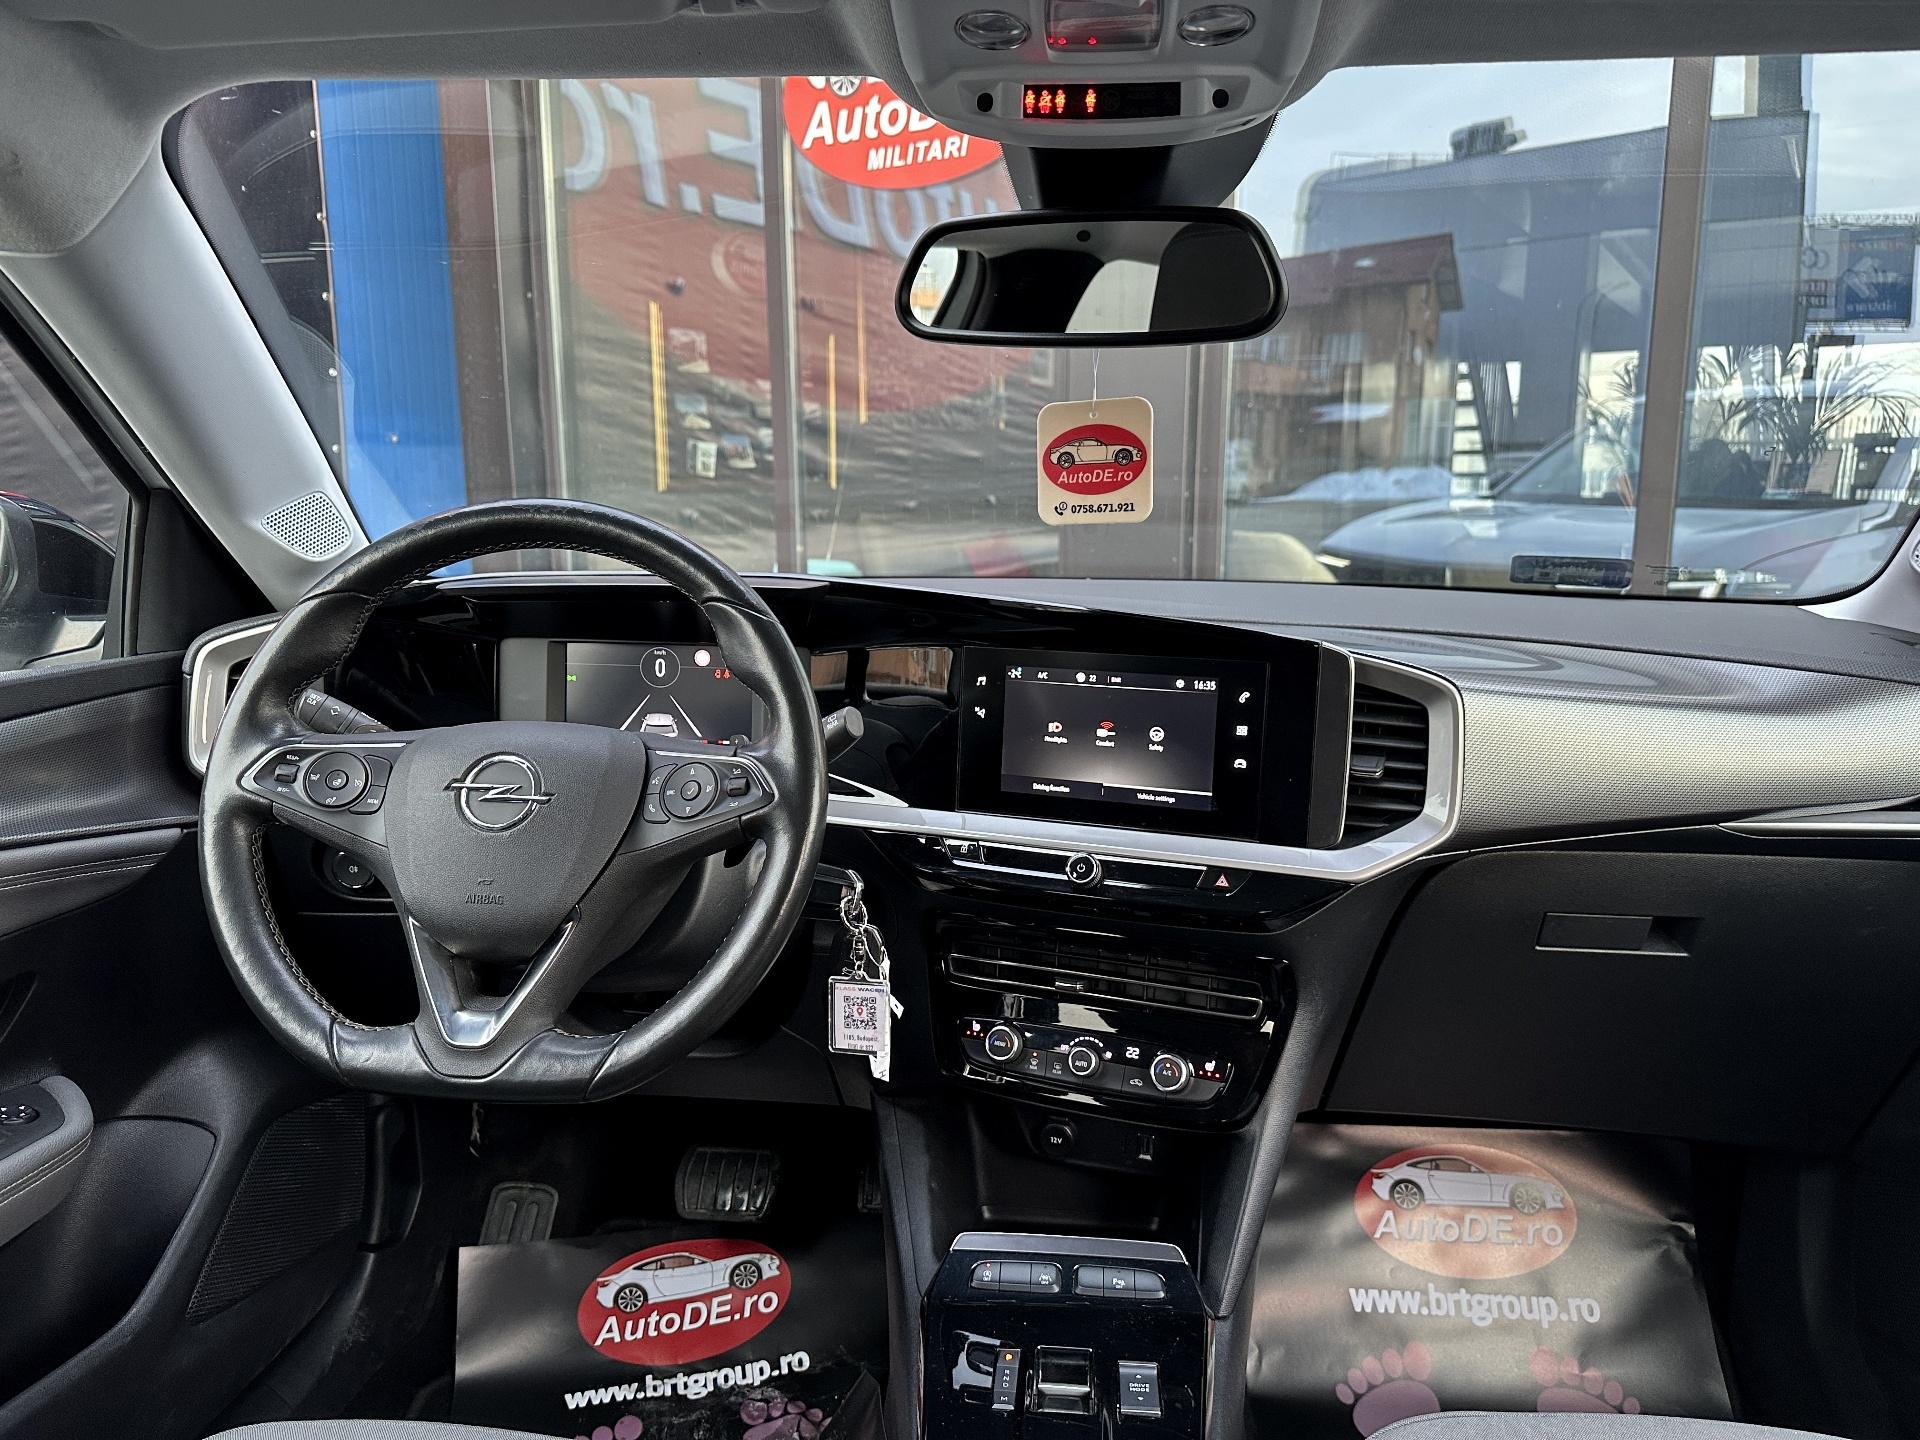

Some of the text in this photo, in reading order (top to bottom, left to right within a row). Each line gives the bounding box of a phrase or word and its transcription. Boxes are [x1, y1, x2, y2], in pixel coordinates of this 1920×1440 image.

[867, 134, 970, 171] MILITARI
[1057, 469, 1133, 484] AutoDE.ro
[1071, 502, 1136, 514] 0758.671.921
[655, 658, 666, 678] 0
[1037, 671, 1049, 680] A/C
[1193, 680, 1217, 691] 16:35
[1136, 792, 1176, 804] Vehicle settings
[465, 893, 504, 906] AIRBAG
[1125, 1046, 1140, 1059] 22
[1075, 1060, 1087, 1068] AUTO
[1162, 1069, 1172, 1077] A/C
[1050, 1136, 1062, 1144] 12V
[1374, 1209, 1564, 1248] AutoDE.ro
[1349, 1283, 1601, 1328] www.brtgroup.ro
[594, 1291, 779, 1346] AutoDE.ro
[564, 1350, 810, 1410] www.brtgroup.ro
